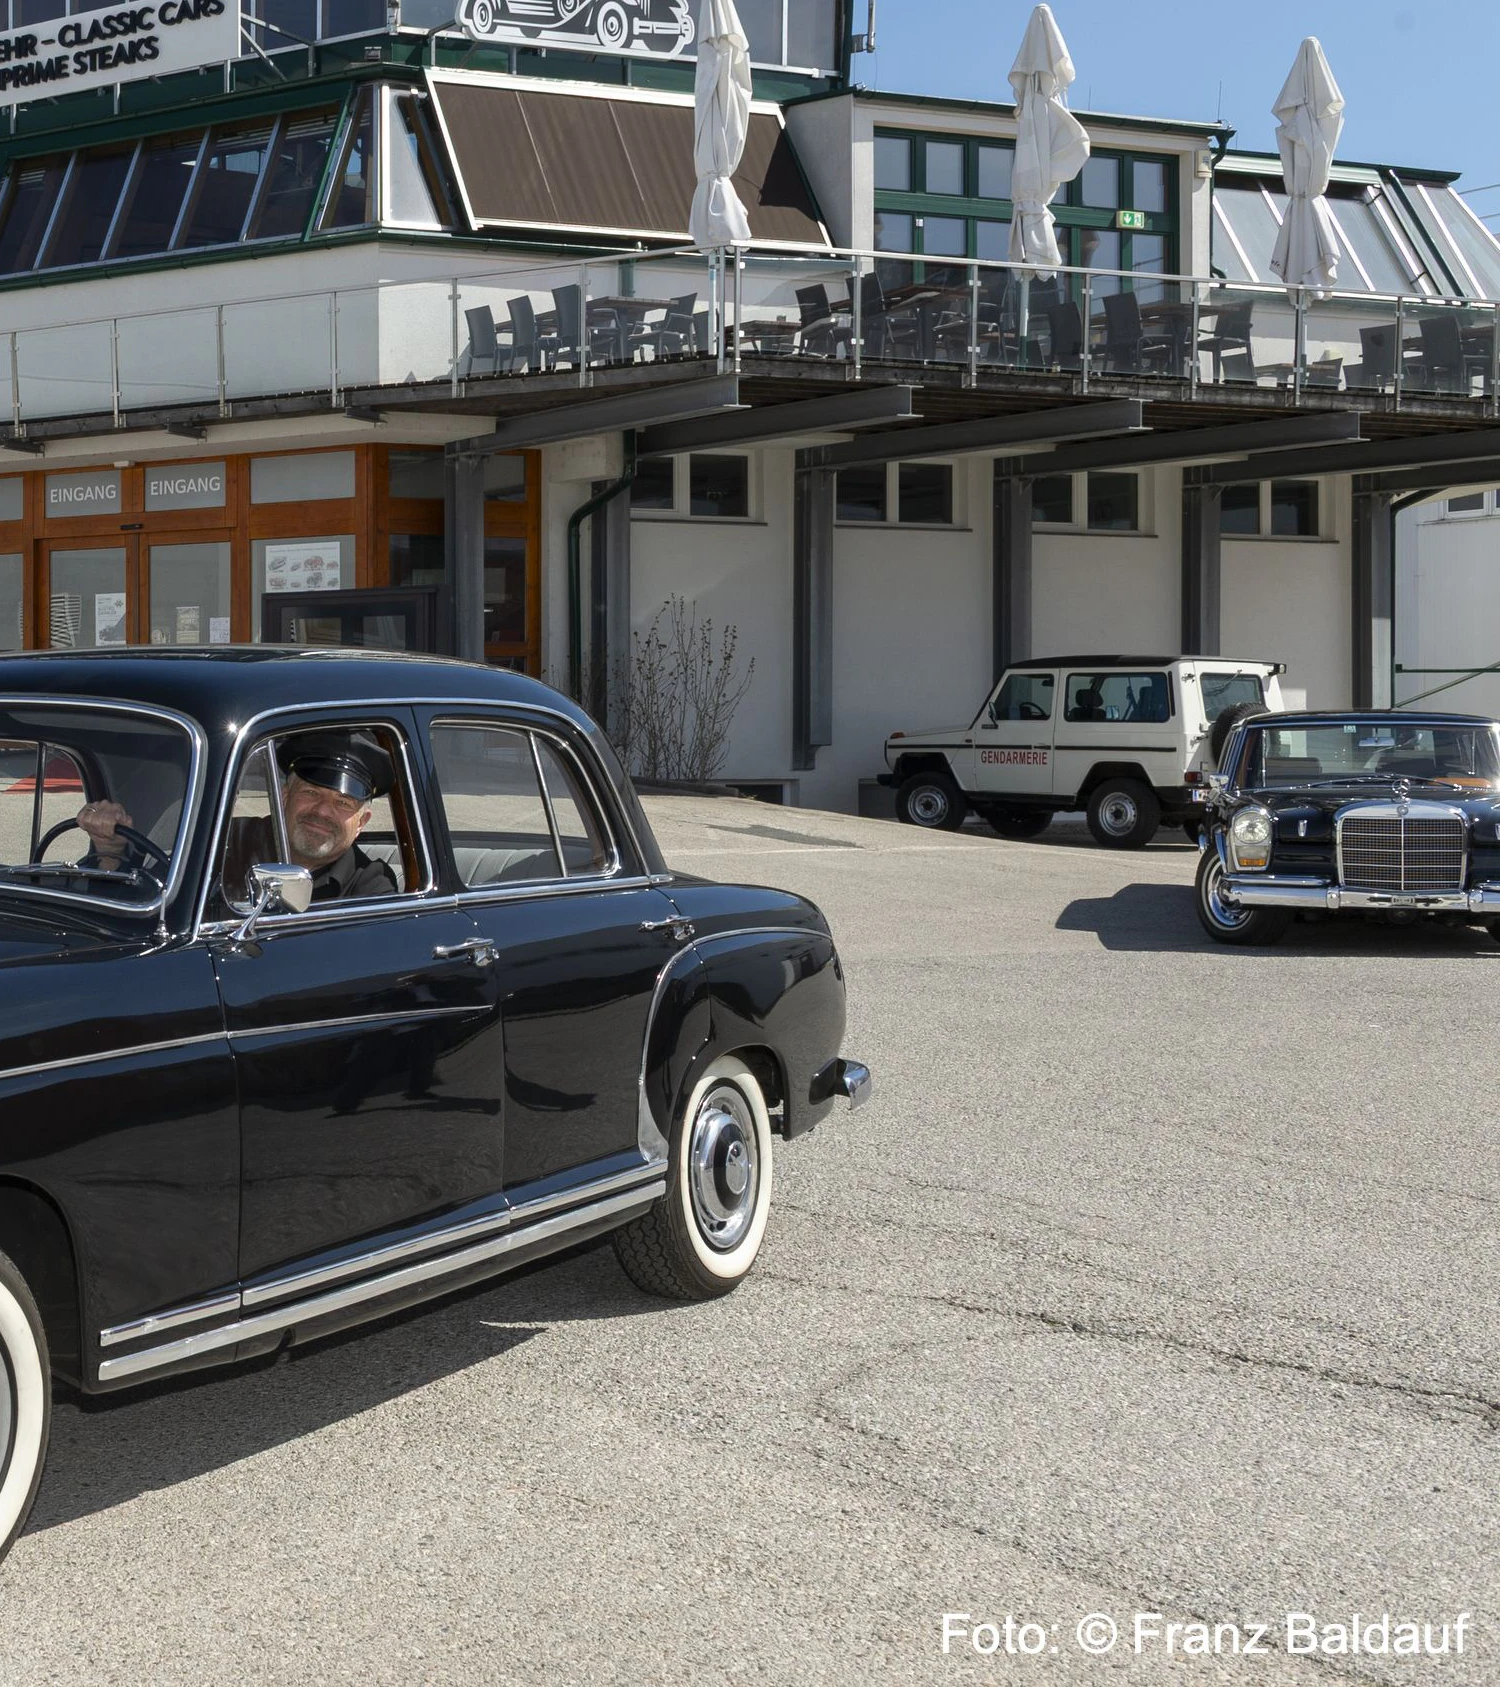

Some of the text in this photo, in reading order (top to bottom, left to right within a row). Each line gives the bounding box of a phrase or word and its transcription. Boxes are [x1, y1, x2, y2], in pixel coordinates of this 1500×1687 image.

[58, 7, 156, 48] CLASSIC
[158, 0, 225, 26] CARS
[0, 55, 70, 91] PRIME
[73, 36, 159, 75] STEAKS
[50, 484, 117, 503] EINGANG
[150, 476, 221, 496] EINGANG
[981, 751, 1048, 765] GENDARMERIE
